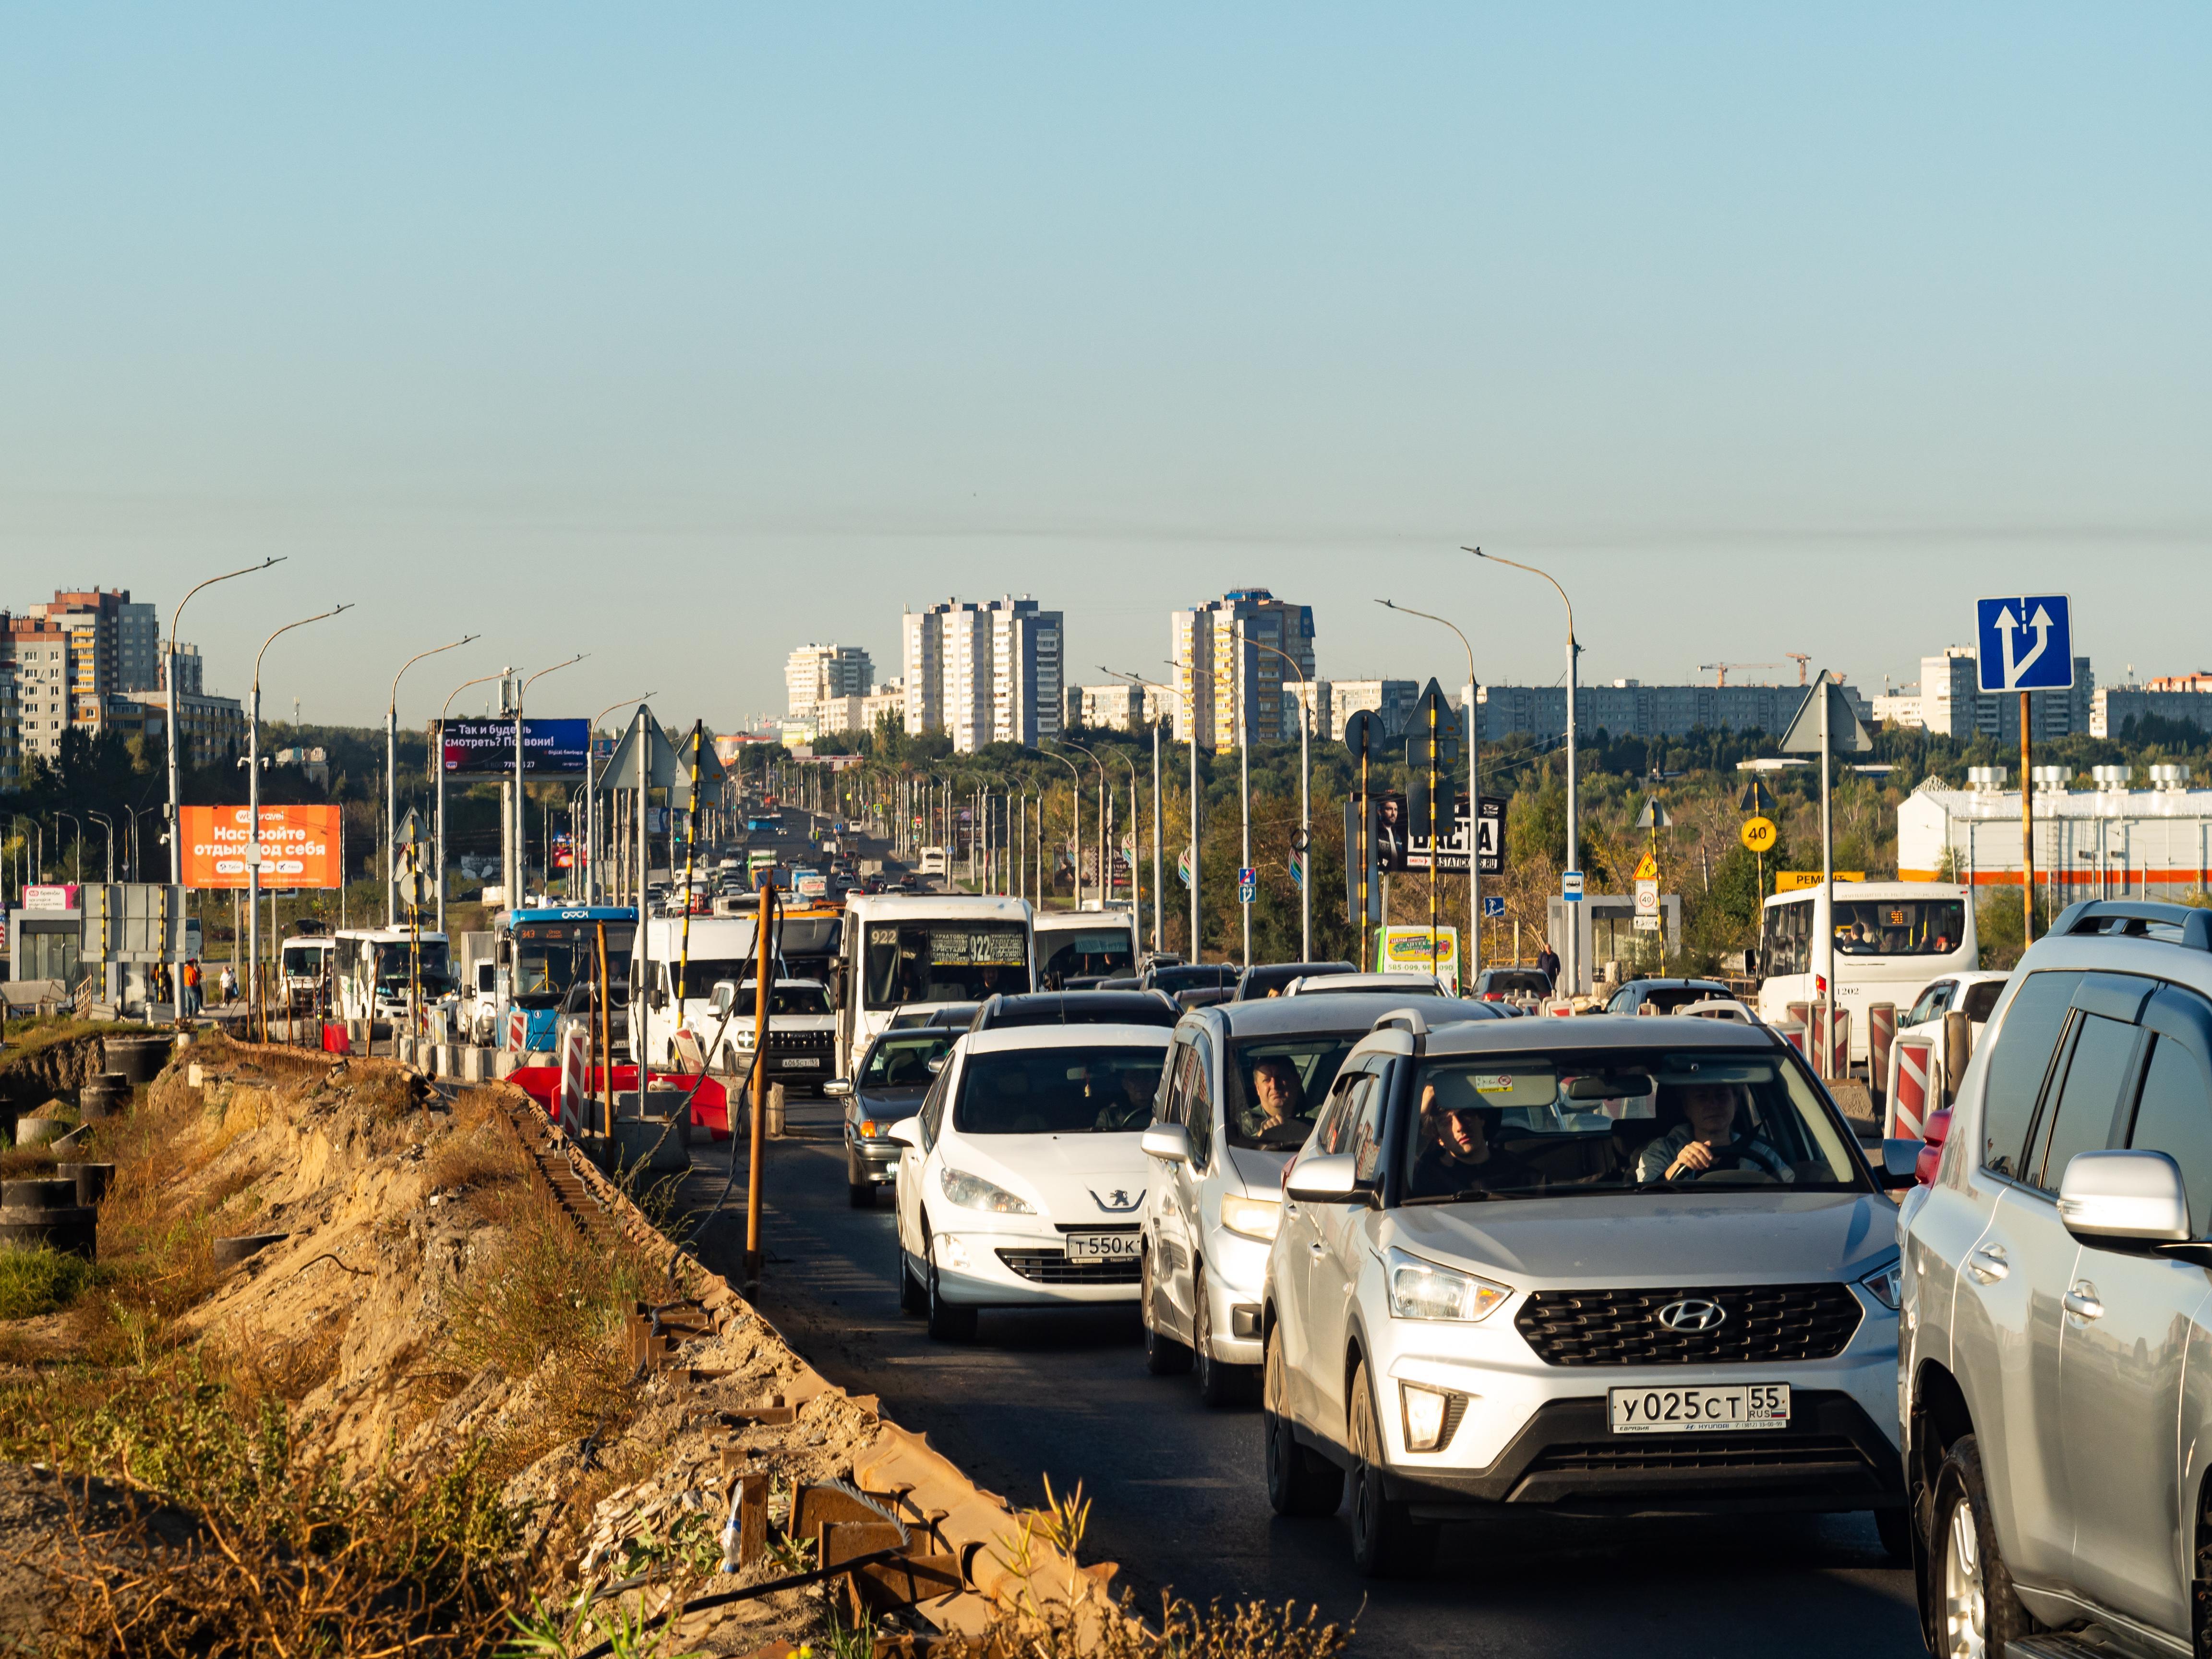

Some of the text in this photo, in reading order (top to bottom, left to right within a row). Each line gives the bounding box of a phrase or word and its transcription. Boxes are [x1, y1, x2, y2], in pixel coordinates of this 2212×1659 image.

[459, 724, 477, 734] Так
[445, 736, 554, 748] смотреть? Повони!
[258, 811, 284, 820] ravel
[1748, 827, 1766, 840] 40
[261, 844, 282, 857] од
[285, 841, 325, 855] себя
[1437, 856, 1495, 868] ASTATICKS.RU
[1891, 911, 1902, 924] 90
[522, 929, 535, 939] 343
[872, 930, 896, 944] 922
[970, 936, 990, 962] 922
[1076, 1237, 1140, 1255] Т550К
[1623, 1387, 1779, 1421] У025СТ 55
[1750, 1410, 1770, 1419] RUS
